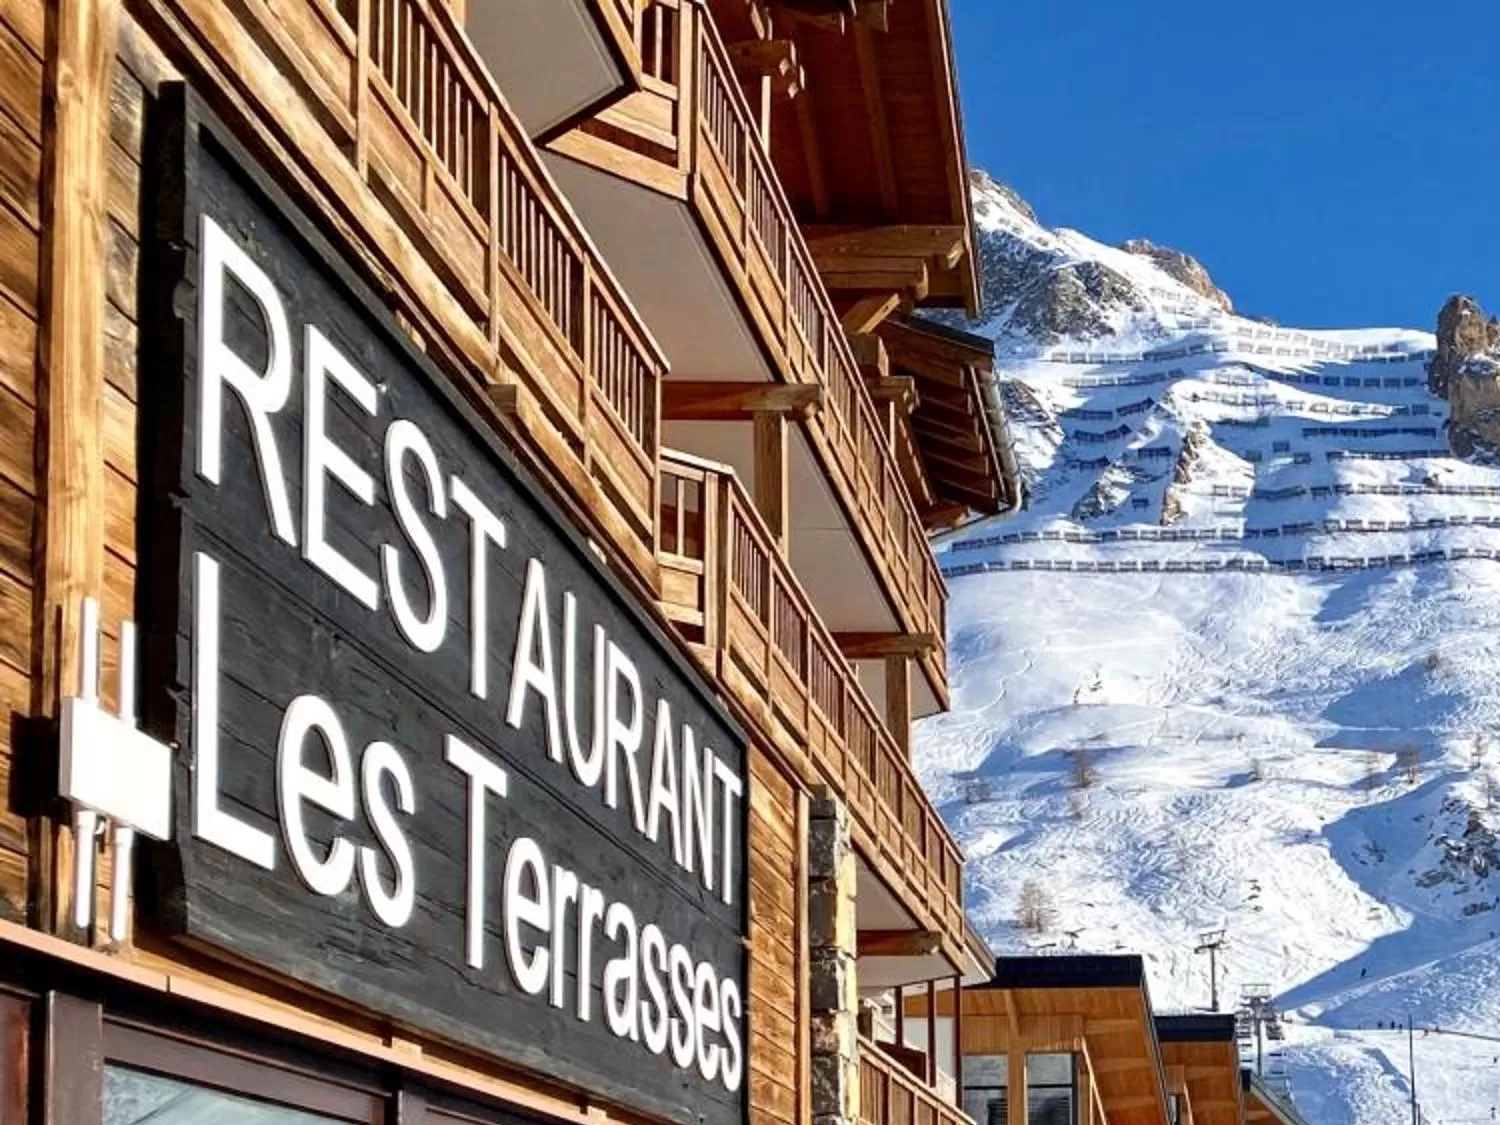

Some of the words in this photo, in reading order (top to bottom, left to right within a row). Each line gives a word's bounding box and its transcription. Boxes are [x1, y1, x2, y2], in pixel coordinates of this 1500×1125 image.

[191, 551, 416, 930] Les
[443, 731, 744, 1093] Terrasses
[196, 213, 743, 906] RESTAURANT
